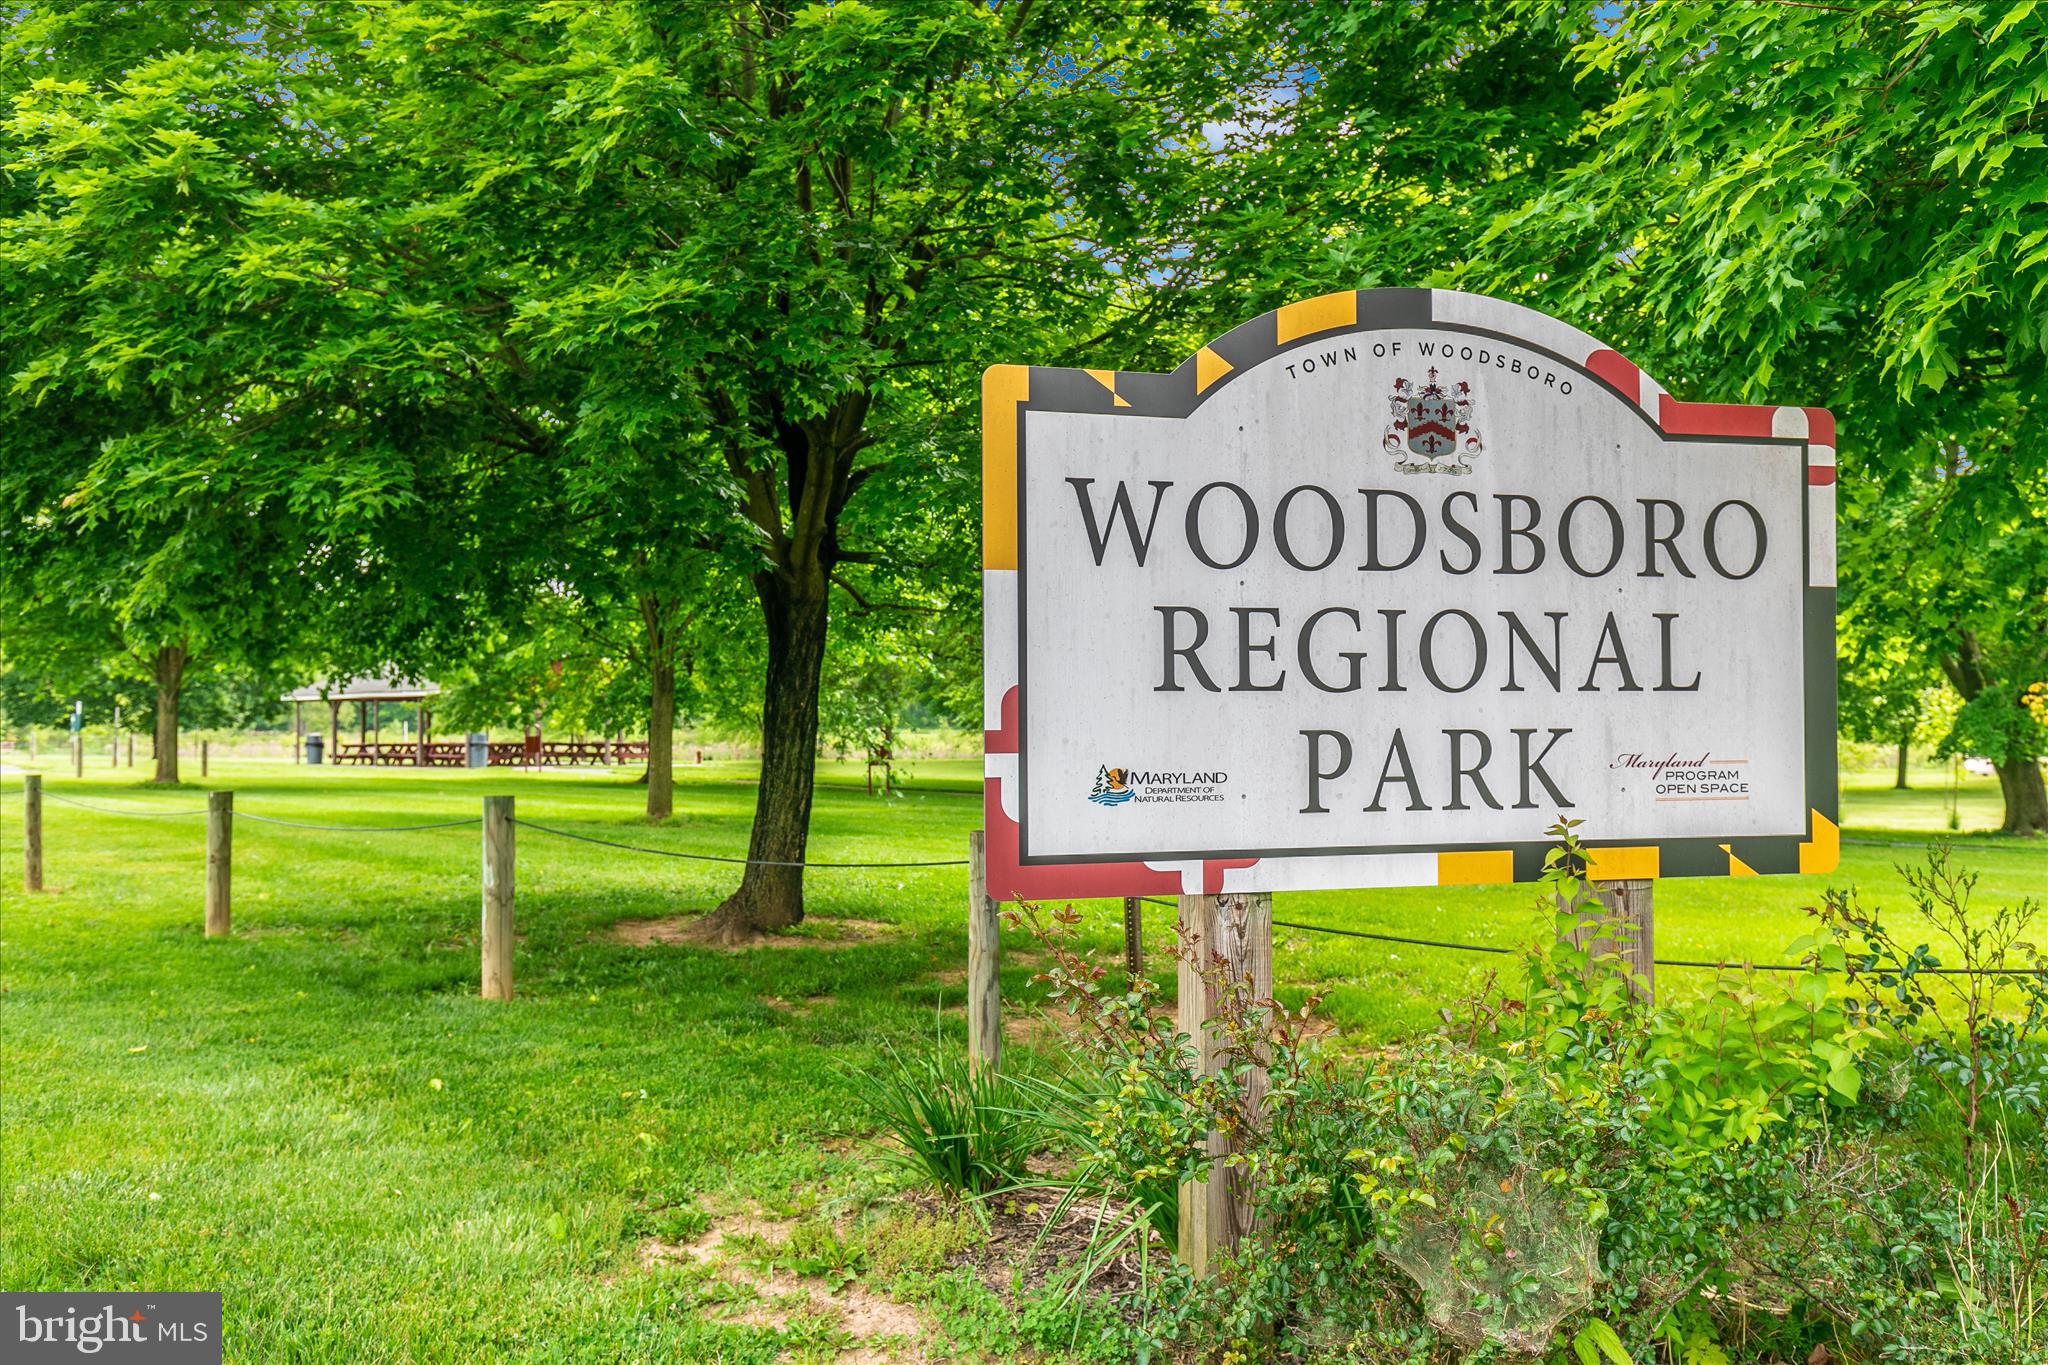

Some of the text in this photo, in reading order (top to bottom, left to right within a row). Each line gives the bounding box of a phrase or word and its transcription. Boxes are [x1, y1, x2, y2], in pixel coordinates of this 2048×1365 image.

[1286, 342, 1572, 395] TOWN OF WOODSBORO
[1065, 477, 1768, 581] WOODSBORO
[1153, 606, 1701, 693] REGIONAL
[1299, 728, 1576, 814] PARK
[1609, 752, 1710, 780] Maryland
[1665, 771, 1739, 781] PROGRAM
[1130, 771, 1228, 785] MARYLAND
[1655, 783, 1749, 794] OPEN SPACE
[1134, 794, 1225, 803] NATURAL RESOURCES
[1145, 786, 1215, 795] DEPARTMENT OF
